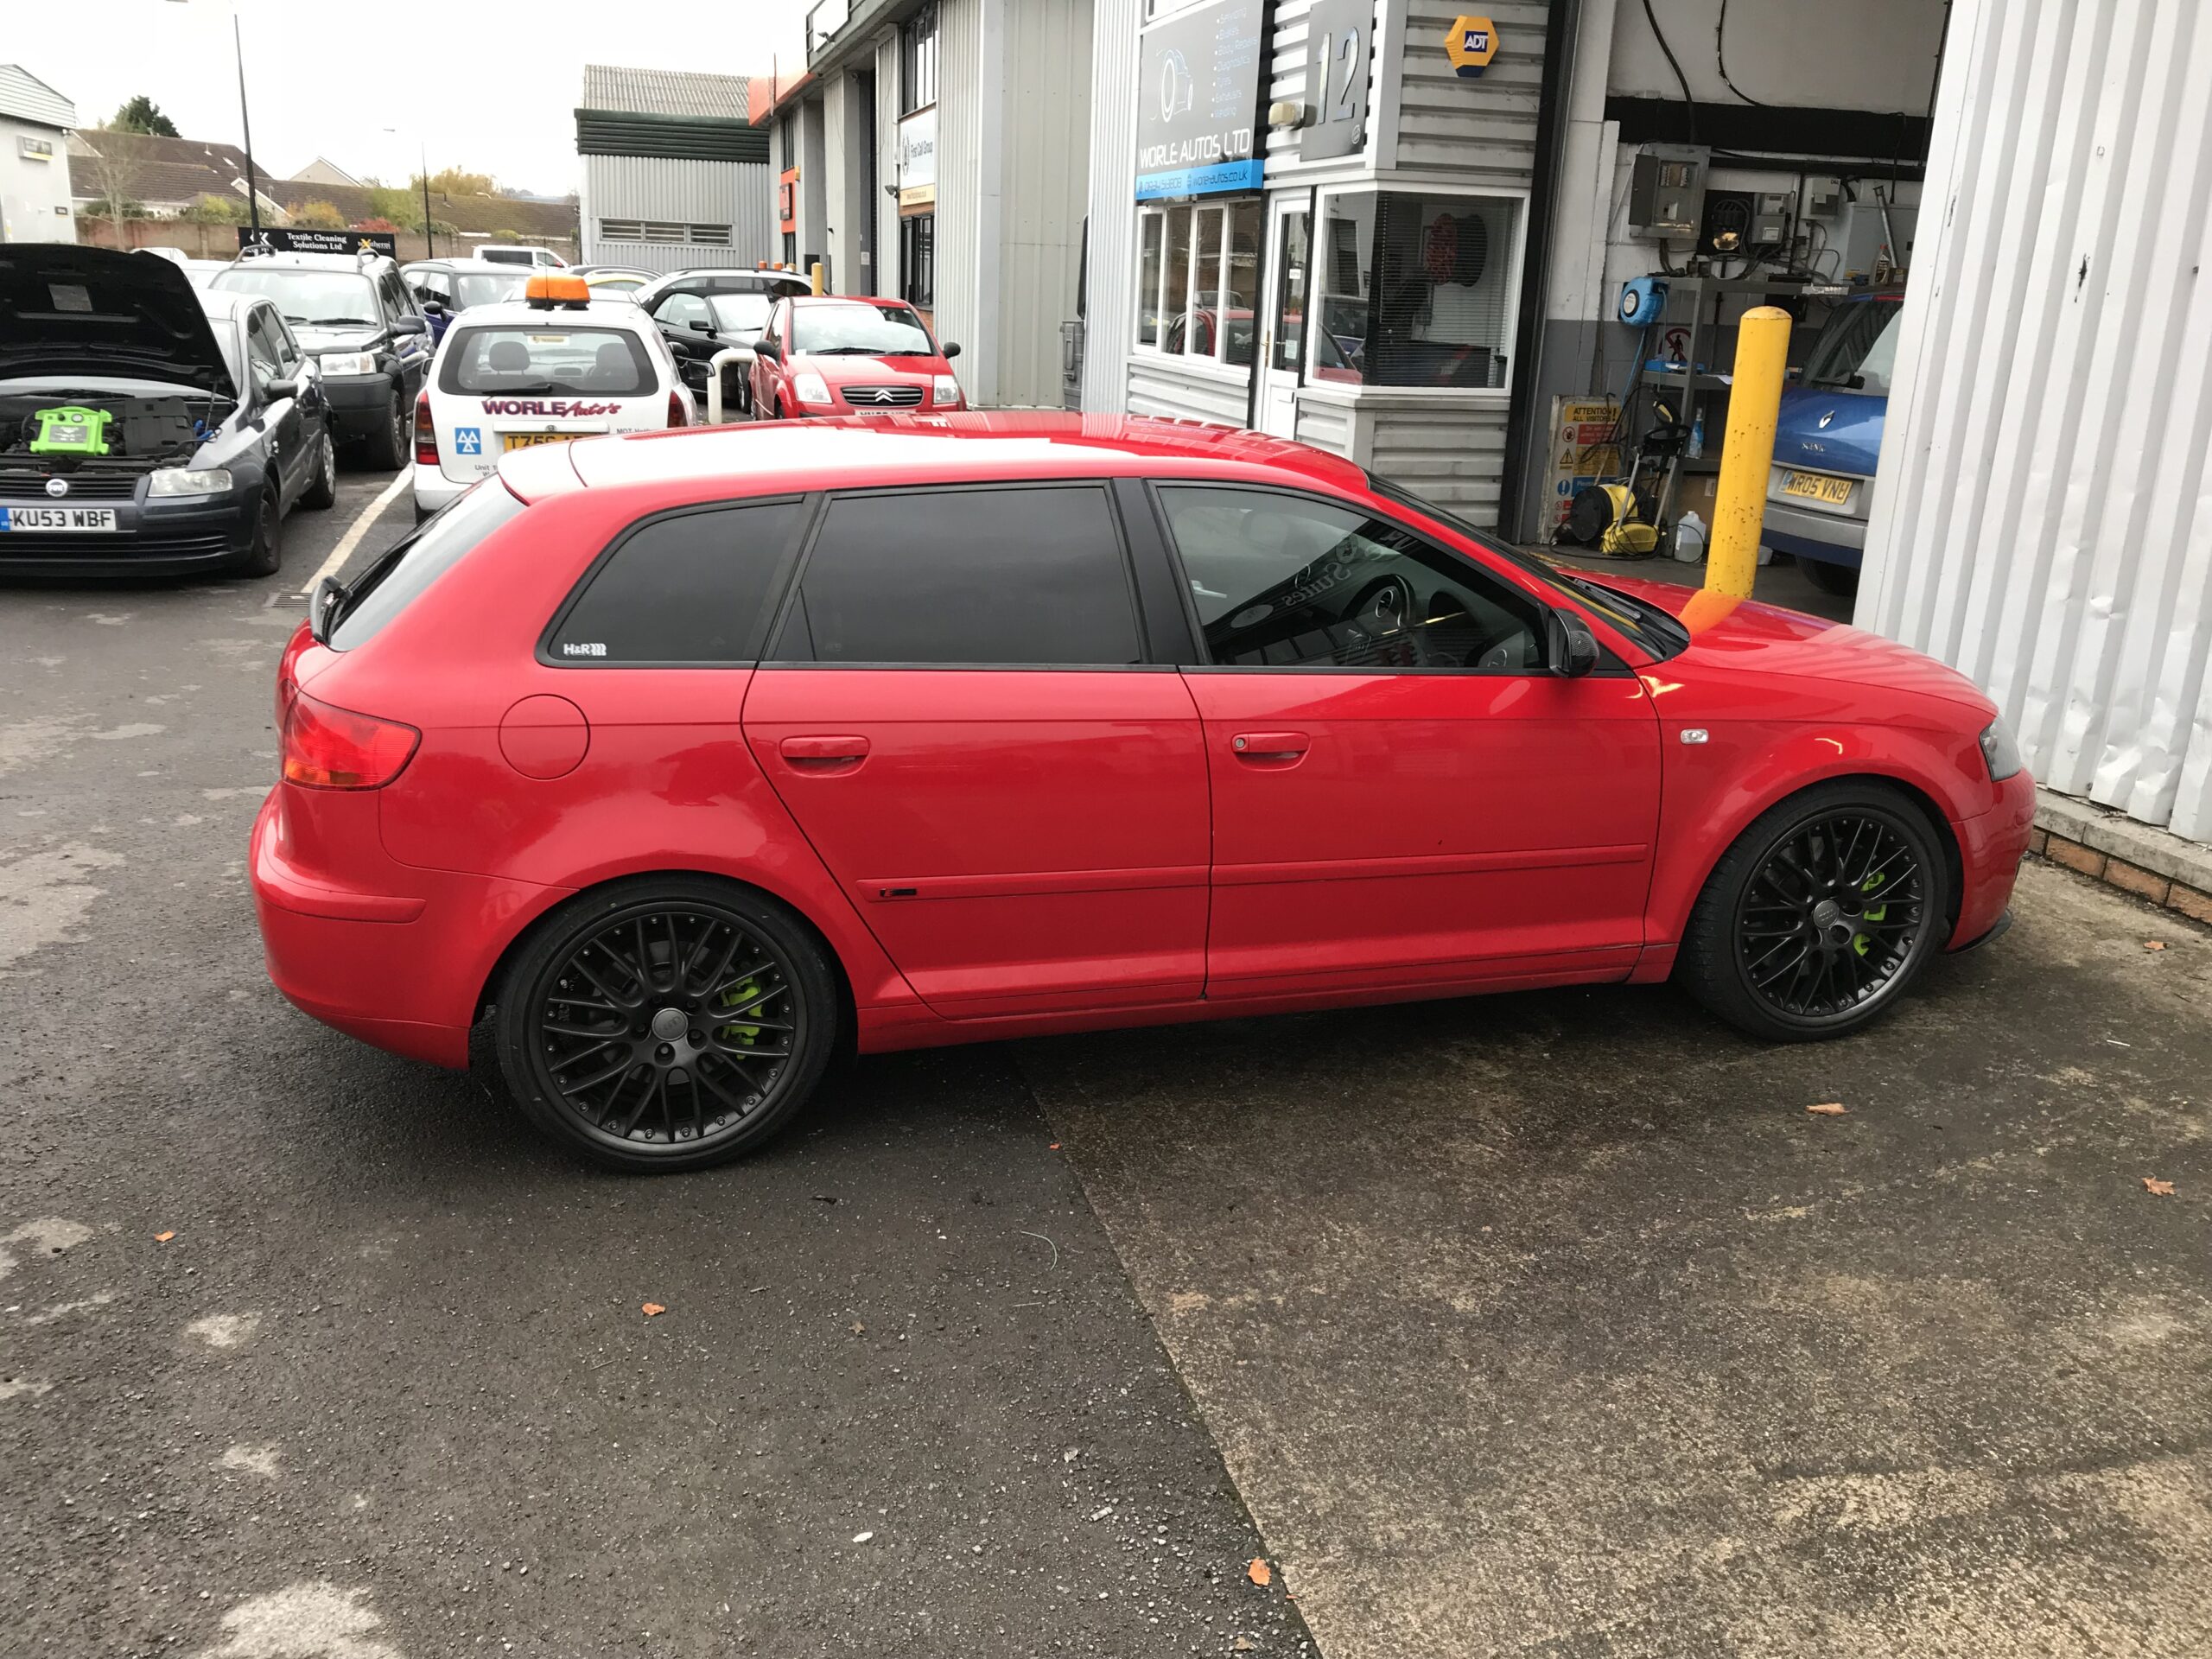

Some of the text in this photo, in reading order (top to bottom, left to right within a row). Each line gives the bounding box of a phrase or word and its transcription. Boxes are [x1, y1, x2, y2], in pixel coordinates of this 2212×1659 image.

[1464, 35, 1489, 50] ADT
[1316, 26, 1360, 124] 12
[1140, 129, 1250, 168] WORLE AUTOS LTD
[286, 232, 346, 244] Textile Cleaning
[293, 241, 328, 250] Solutions
[481, 400, 567, 416] WORLE
[13, 510, 111, 527] KU53 WBF
